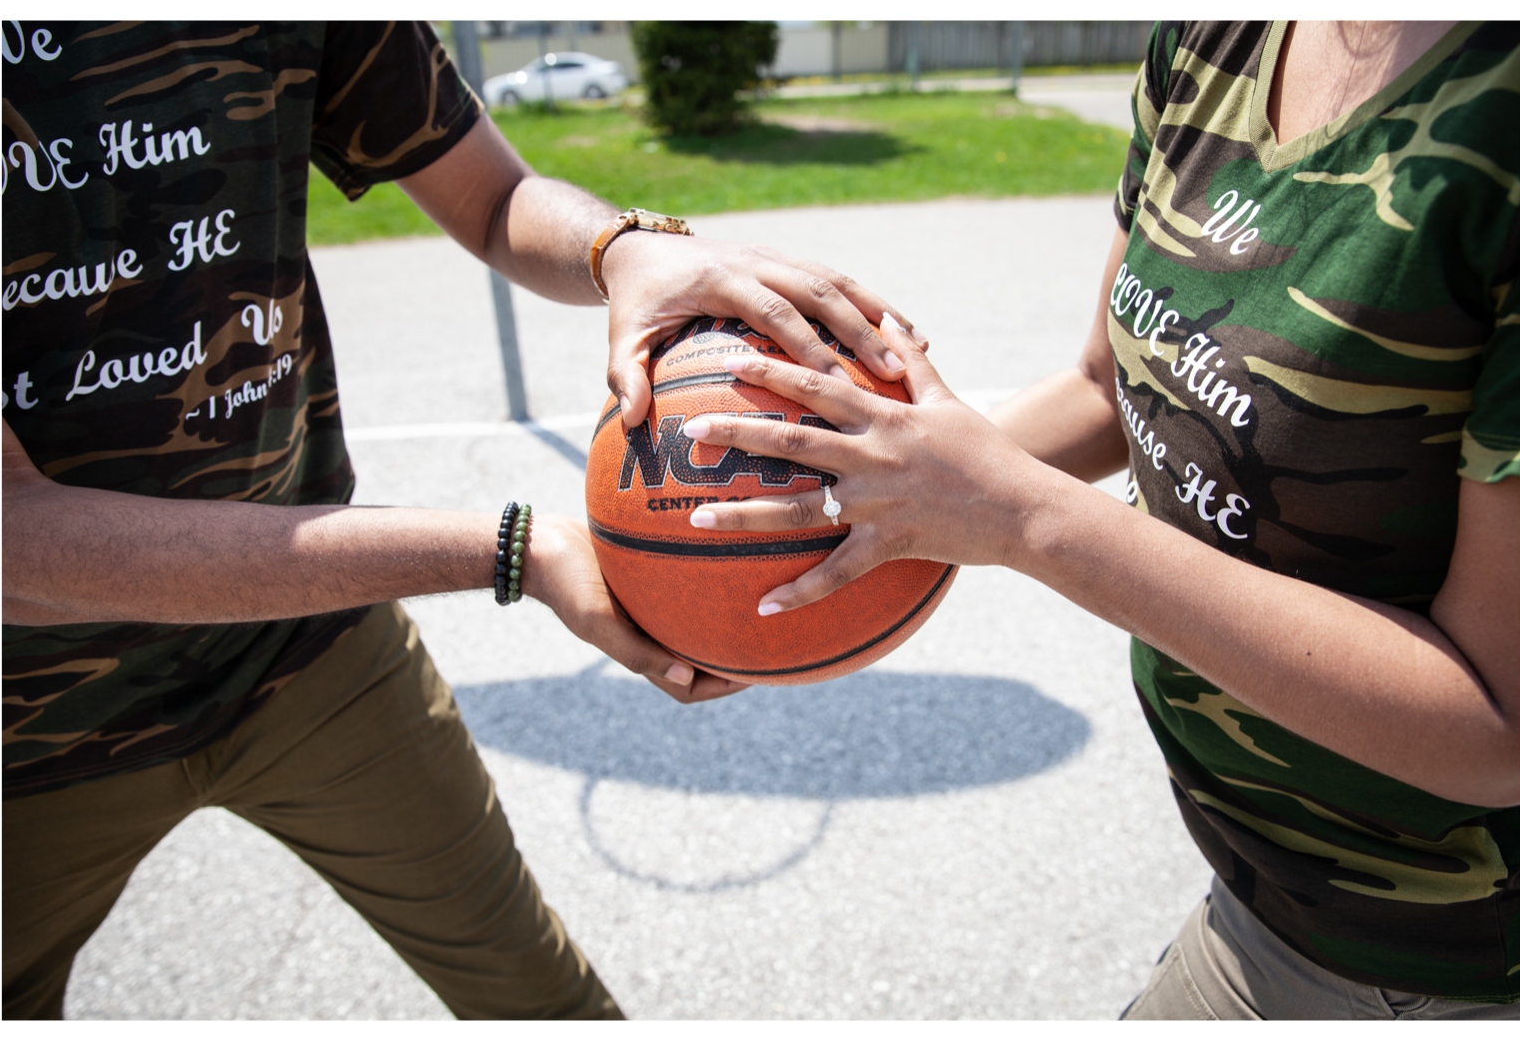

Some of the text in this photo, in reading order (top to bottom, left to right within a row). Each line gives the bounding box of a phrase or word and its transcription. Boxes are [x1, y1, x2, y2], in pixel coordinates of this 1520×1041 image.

[98, 119, 211, 176] Him
[167, 209, 241, 272] HE
[1201, 189, 1262, 255] We
[65, 320, 207, 401] Loved
[665, 344, 752, 367] COMPOSITE
[1110, 262, 1253, 428] LOVE Him
[223, 380, 267, 419] John
[1175, 461, 1251, 539] HE
